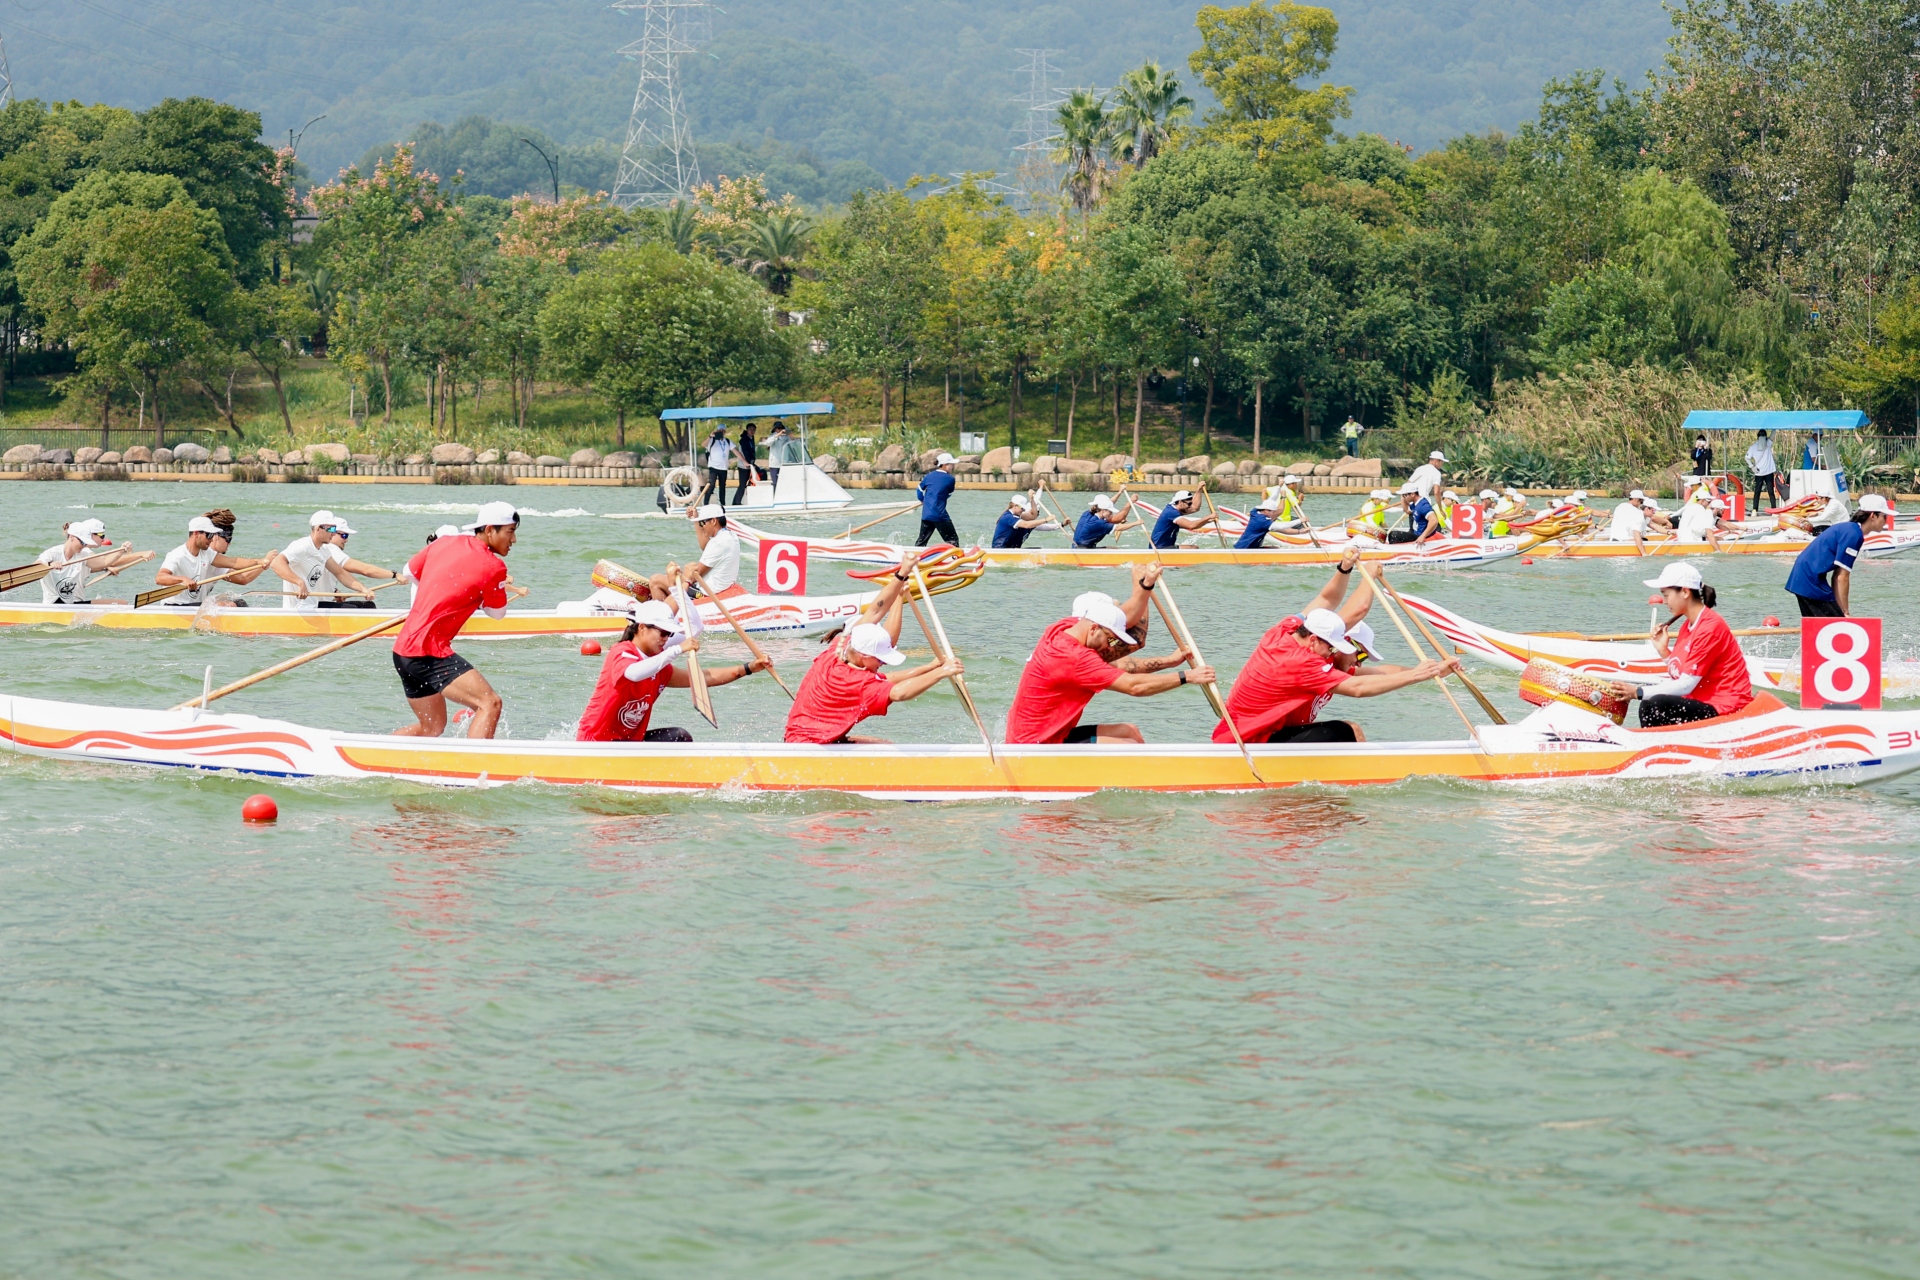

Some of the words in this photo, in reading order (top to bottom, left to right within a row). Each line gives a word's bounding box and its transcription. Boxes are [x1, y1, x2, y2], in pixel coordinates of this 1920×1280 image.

[1458, 505, 1477, 536] 3
[1726, 495, 1736, 520] 1
[1484, 543, 1516, 553] BYD
[765, 542, 800, 592] 6
[807, 604, 858, 620] BYD
[1813, 621, 1871, 703] 8
